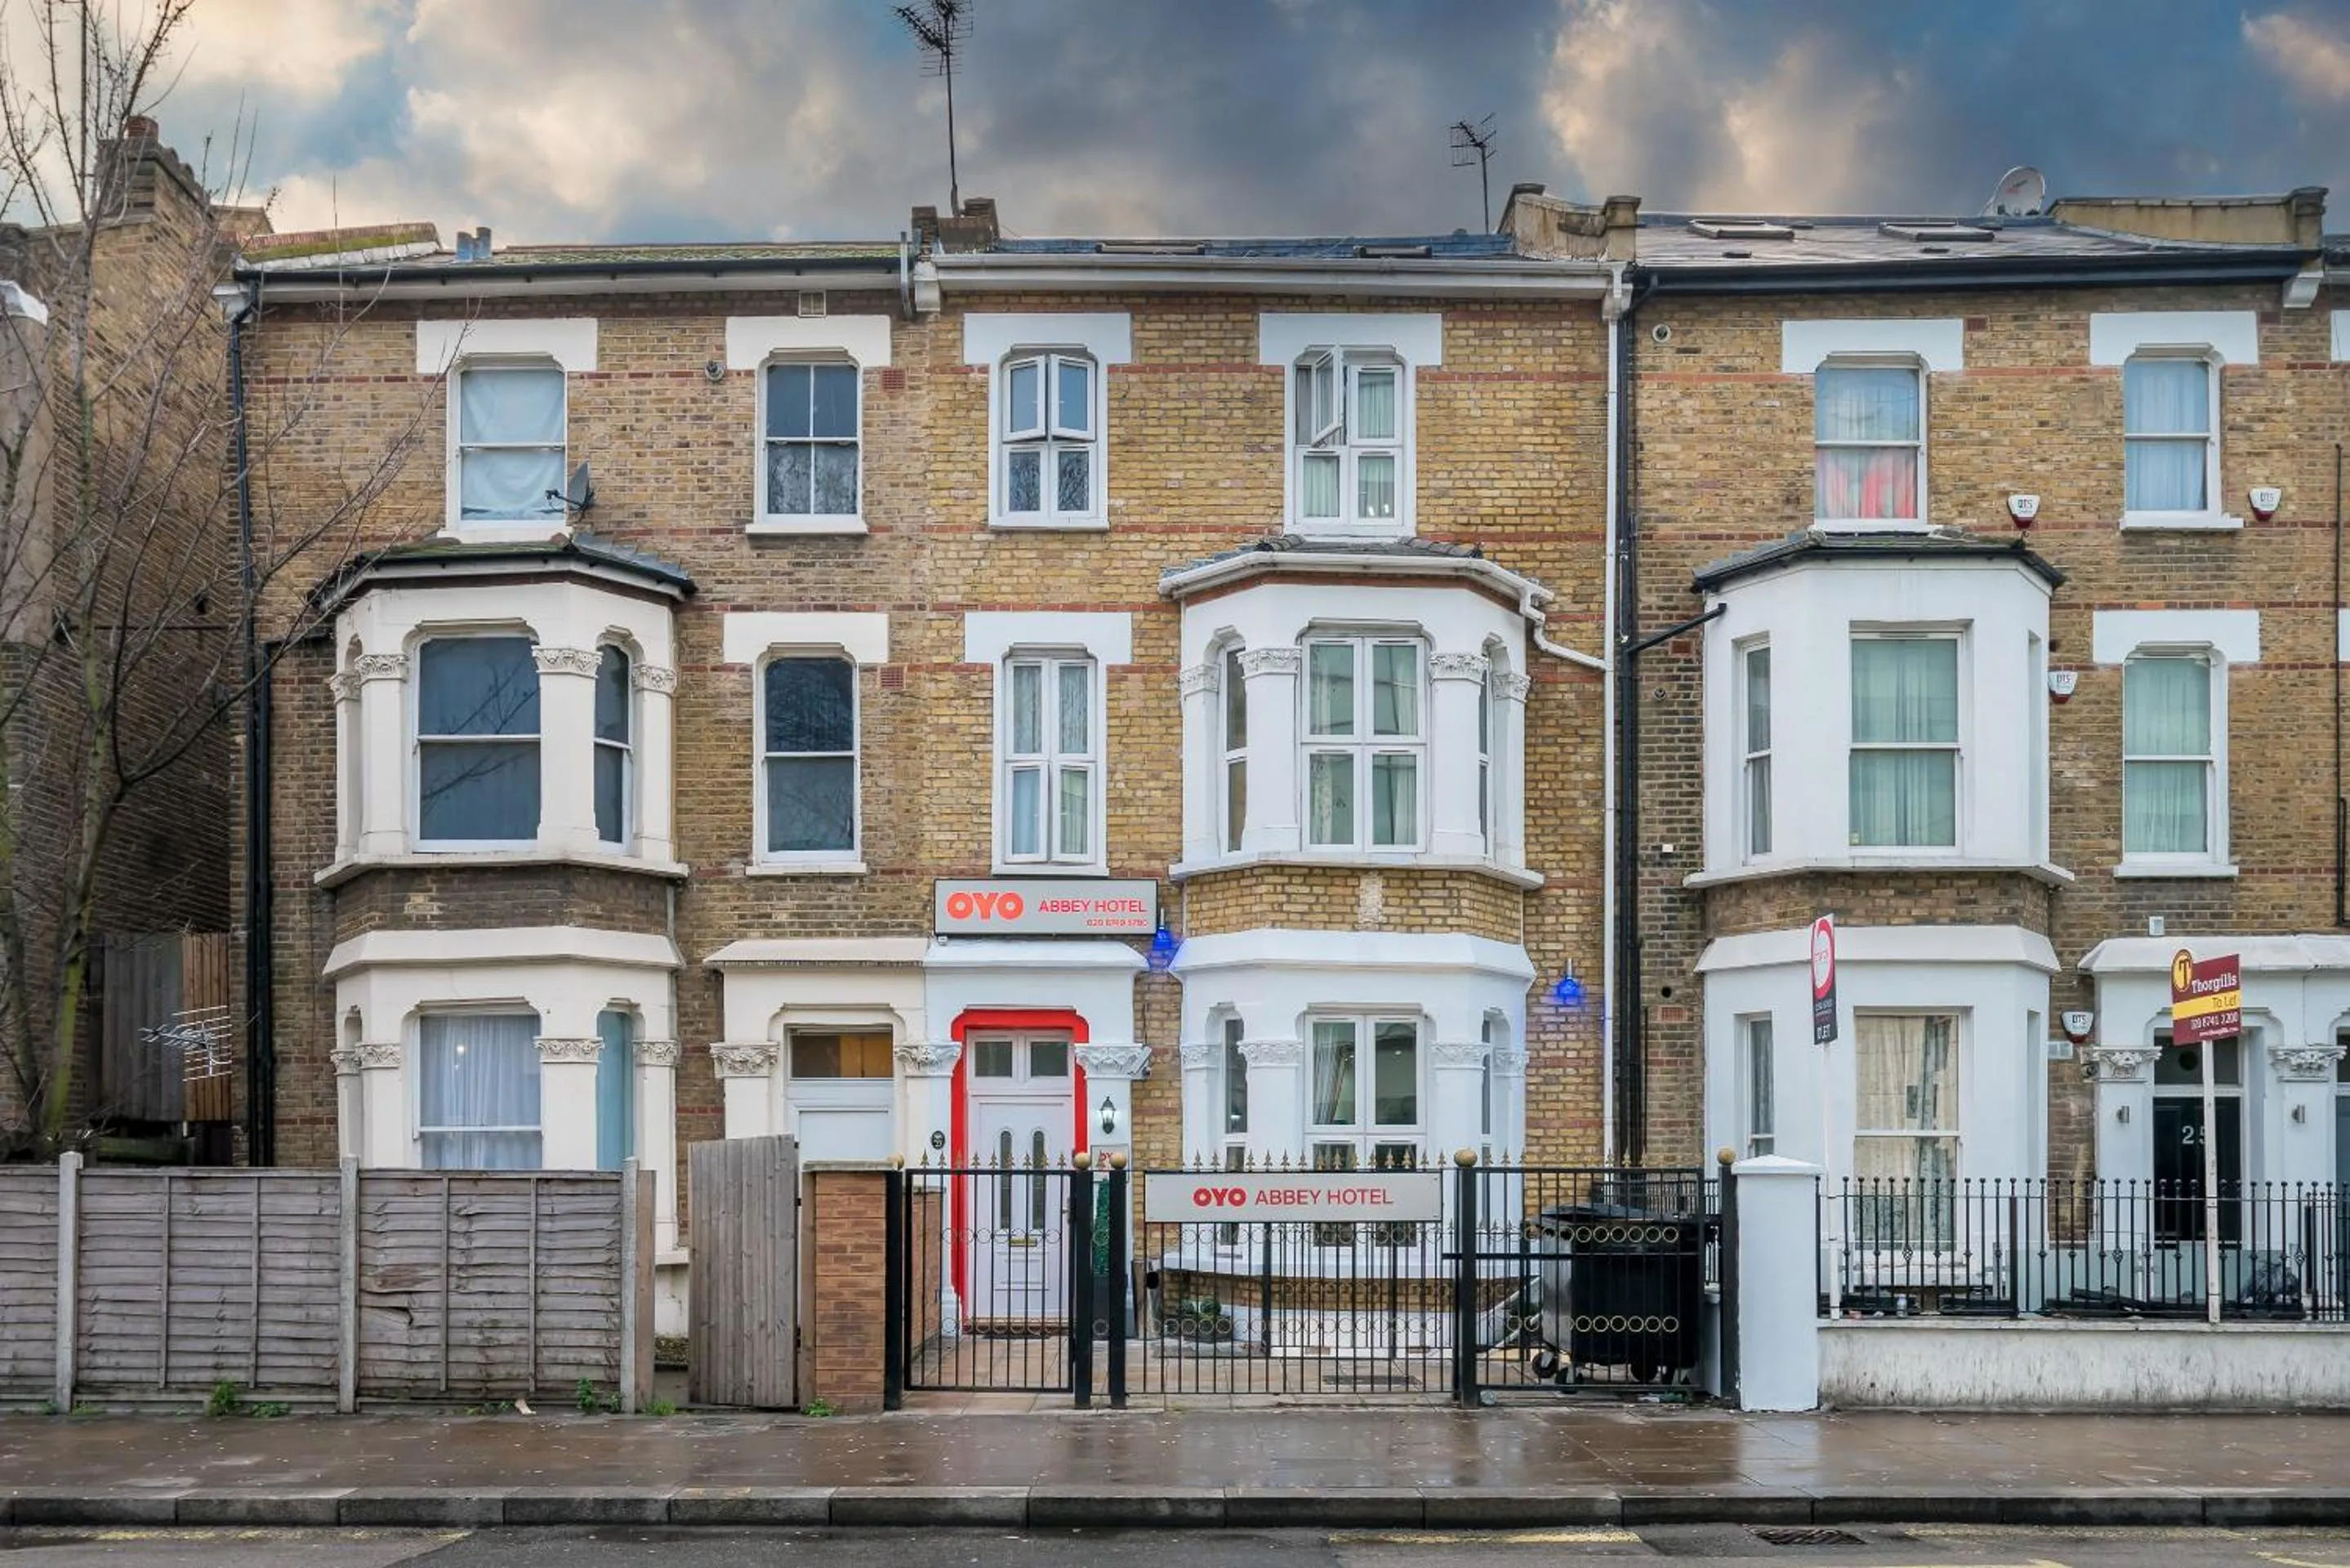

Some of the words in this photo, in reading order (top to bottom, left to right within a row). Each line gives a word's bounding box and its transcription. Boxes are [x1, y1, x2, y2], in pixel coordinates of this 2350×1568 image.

[947, 893, 1023, 920] OYO
[1039, 900, 1090, 912] ABBEY
[1095, 900, 1147, 912] HOTEL
[2192, 972, 2237, 994] Thorgills
[2212, 996, 2222, 1009] To
[1193, 1188, 1246, 1207] OYO
[1255, 1189, 1322, 1205] ABBEY
[1328, 1189, 1394, 1205] HOTEL
